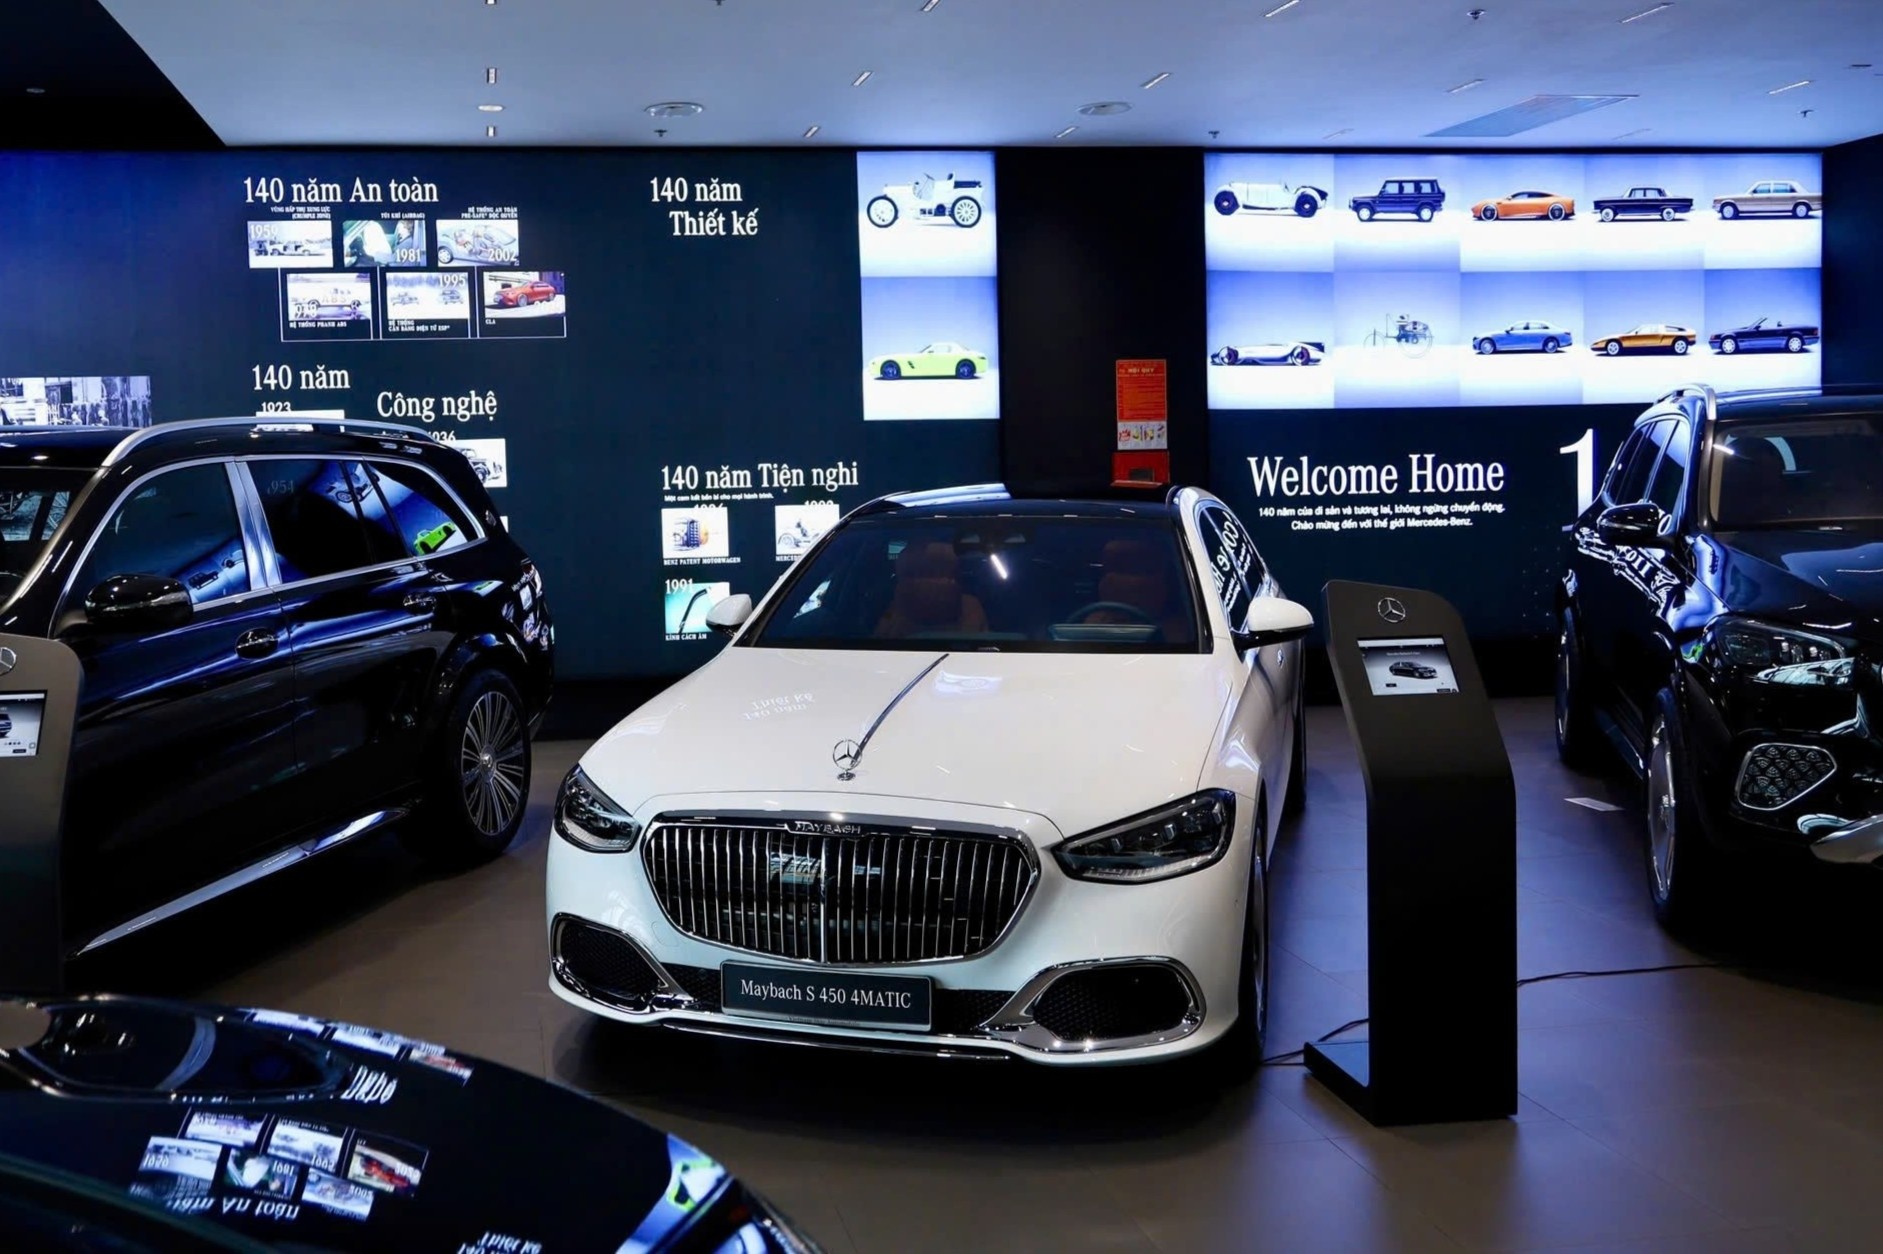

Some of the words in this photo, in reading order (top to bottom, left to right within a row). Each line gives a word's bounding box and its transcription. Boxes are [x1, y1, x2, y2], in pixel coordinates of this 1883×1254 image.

[243, 177, 285, 203] 140
[291, 178, 342, 202] năm
[349, 177, 384, 203] An
[389, 176, 439, 203] toàn
[650, 176, 688, 202] 140
[694, 177, 742, 202] năm
[249, 224, 279, 239] 1959
[669, 208, 726, 236] Thiết
[731, 208, 759, 236] kế
[395, 249, 421, 263] 1981
[488, 248, 517, 262] 2002
[438, 274, 466, 288] 1995
[251, 365, 292, 391] 140
[300, 364, 350, 390] năm
[377, 392, 435, 422] Công
[442, 390, 497, 422] nghệ
[661, 465, 698, 490] 140
[705, 465, 752, 489] năm
[757, 463, 805, 493] Tiện
[811, 462, 858, 491] nghi
[1247, 455, 1398, 497] Welcome
[1408, 453, 1504, 493] Home
[1259, 507, 1275, 517] 140
[1276, 507, 1296, 517] năm
[1297, 506, 1313, 516] của
[1314, 506, 1323, 516] di
[1325, 505, 1340, 516] sản
[1342, 505, 1352, 515] và
[1354, 505, 1379, 516] tương
[1380, 504, 1393, 515] lai,
[1394, 504, 1421, 515] không
[1422, 503, 1449, 515] ngừng
[1450, 501, 1480, 514] chuyển
[1482, 502, 1505, 513] động.
[1291, 520, 1314, 530] Chào
[1315, 520, 1340, 531] mừng
[1341, 518, 1358, 529] đến
[1359, 518, 1372, 529] với
[1373, 517, 1388, 528] thế
[1389, 518, 1405, 530] giới
[1406, 517, 1473, 528] Mercedes-Benz.
[702, 557, 741, 565] MOTORWAGEN
[795, 821, 861, 834] MAYBACH
[740, 979, 802, 1001] Maybach
[806, 986, 815, 1002] S
[819, 988, 846, 1004] 450
[851, 989, 911, 1009] 4MATIC
